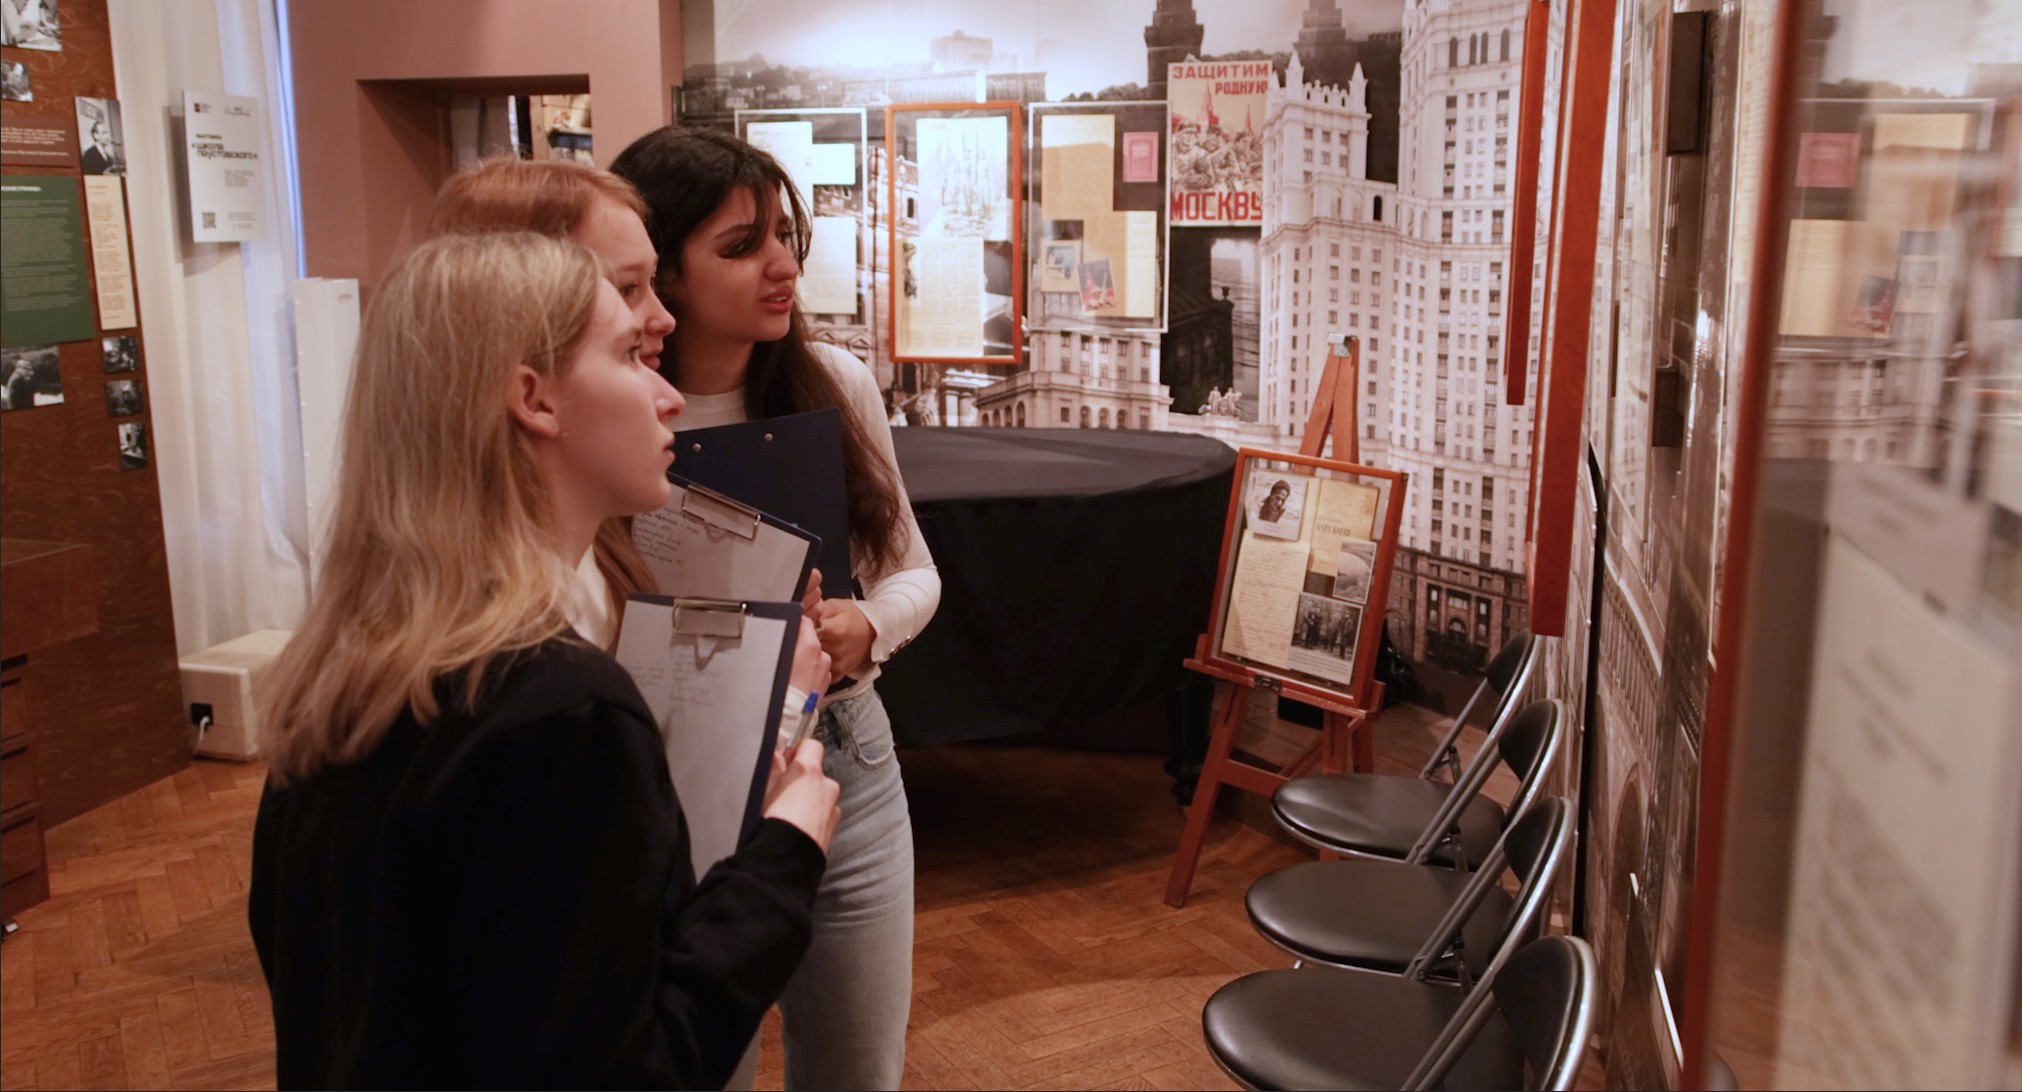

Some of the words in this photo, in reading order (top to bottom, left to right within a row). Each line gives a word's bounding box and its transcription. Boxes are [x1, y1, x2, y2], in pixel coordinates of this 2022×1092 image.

[1172, 64, 1269, 80] ЗАЩИТИМ
[1214, 81, 1268, 95] РОДНУЮ
[1170, 191, 1263, 220] МОСКВУ
